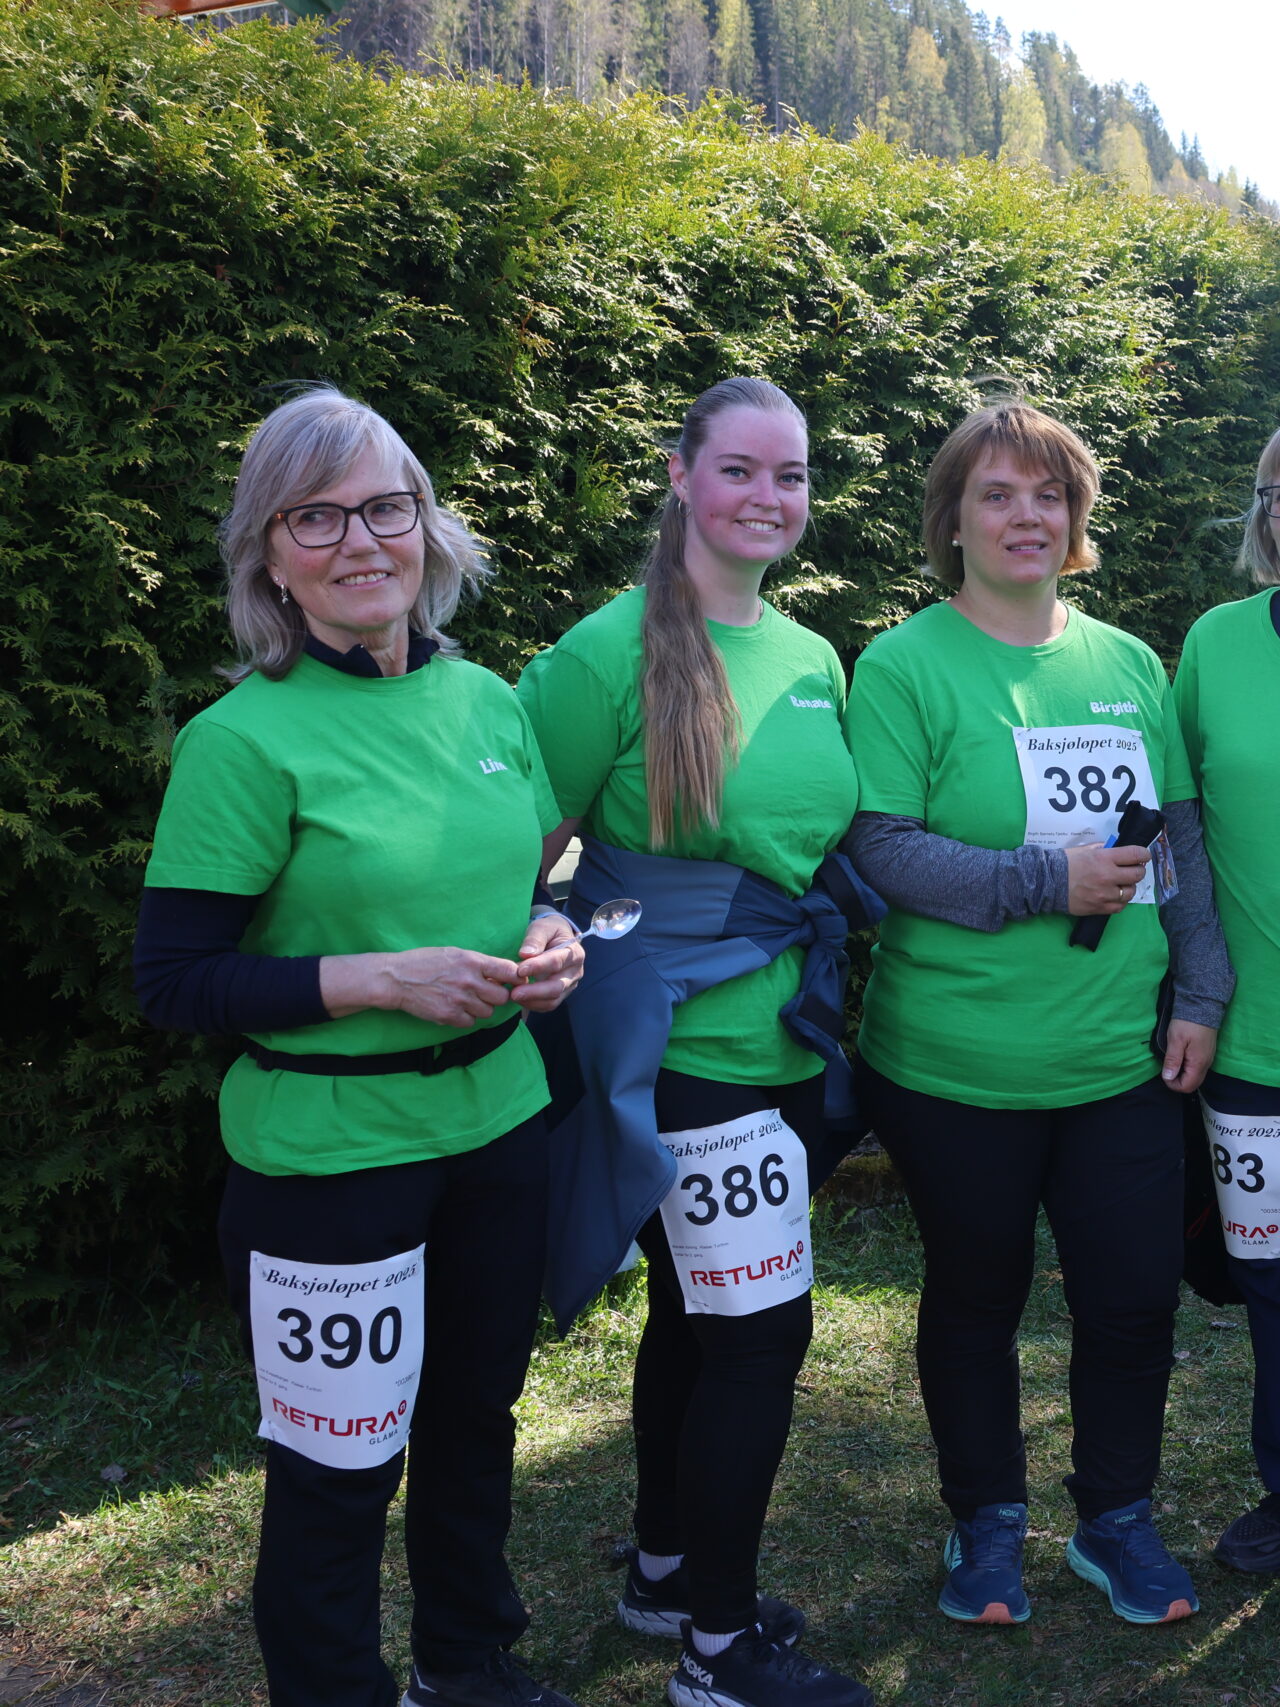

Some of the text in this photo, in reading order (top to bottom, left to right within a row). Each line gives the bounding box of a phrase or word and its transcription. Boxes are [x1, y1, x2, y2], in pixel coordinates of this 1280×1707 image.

[1090, 701, 1138, 716] Birgith
[1027, 737, 1137, 754] Baksjøløpet 2025
[1043, 765, 1137, 813] 382
[758, 1121, 783, 1138] 2025
[1212, 1143, 1266, 1193] 83
[680, 1153, 790, 1226] 386
[1221, 1214, 1268, 1238] URA
[265, 1263, 418, 1298] Baksjøløpet 2025
[689, 1248, 801, 1287] RETURA
[276, 1306, 403, 1370] 390
[271, 1397, 399, 1438] RETURA
[680, 1650, 714, 1688] HOKA
